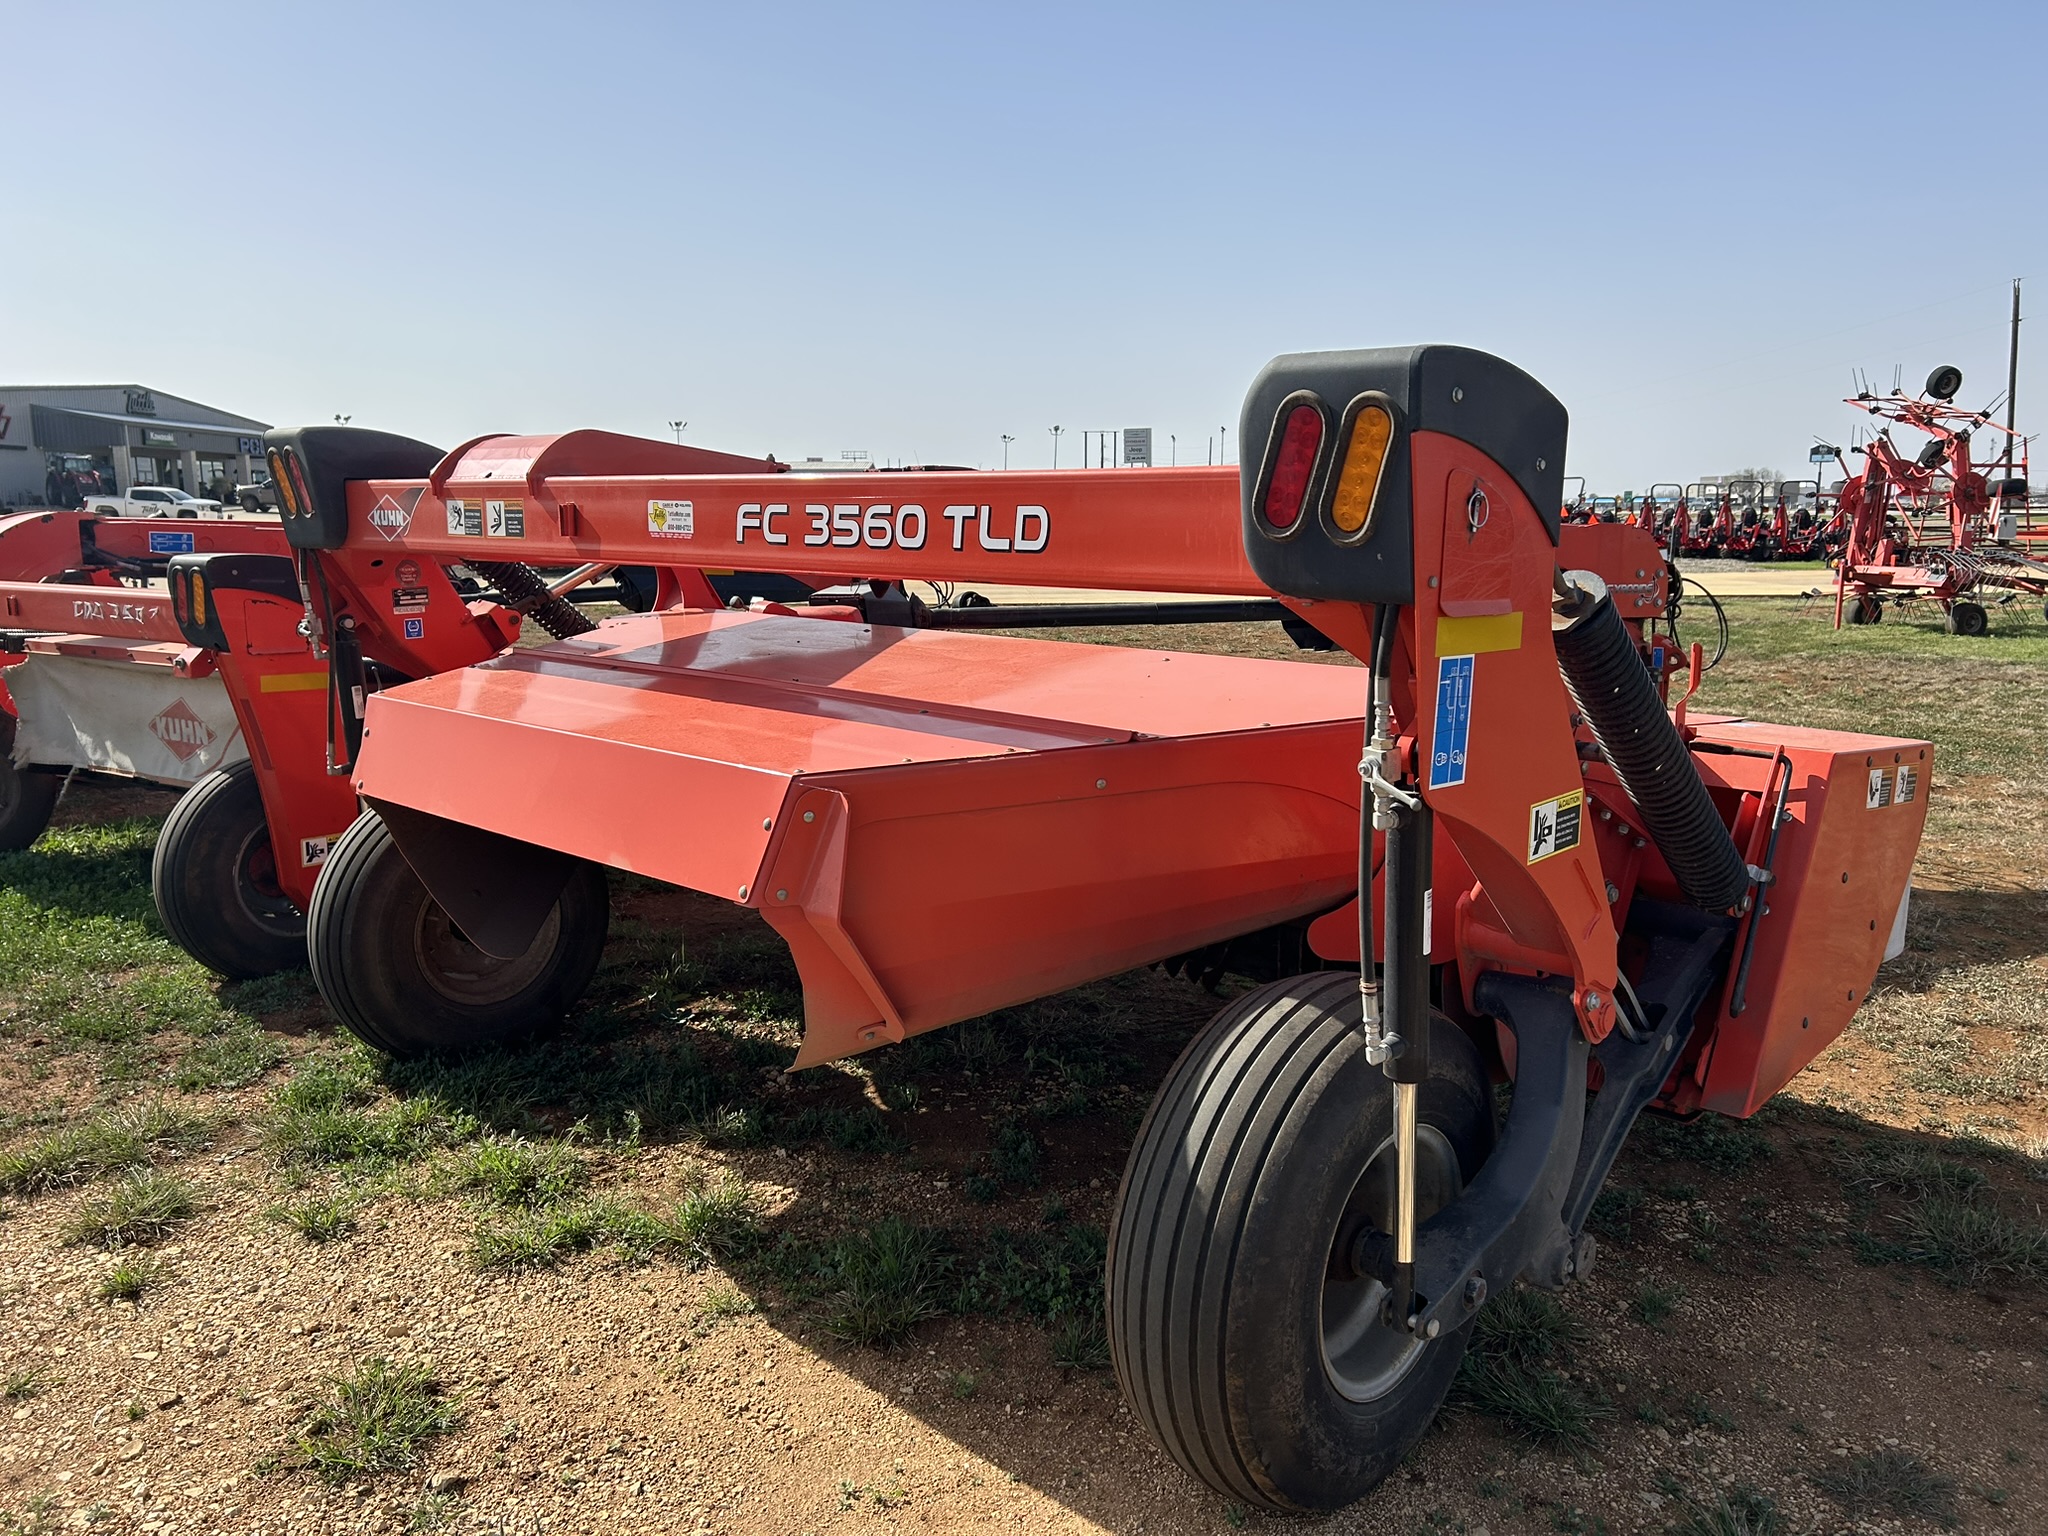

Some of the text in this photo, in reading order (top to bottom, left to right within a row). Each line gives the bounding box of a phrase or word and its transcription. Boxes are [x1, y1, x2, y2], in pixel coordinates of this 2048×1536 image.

[373, 510, 404, 526] KUHN
[736, 504, 1049, 553] FC 3560 TLD
[155, 716, 209, 746] KUHN
